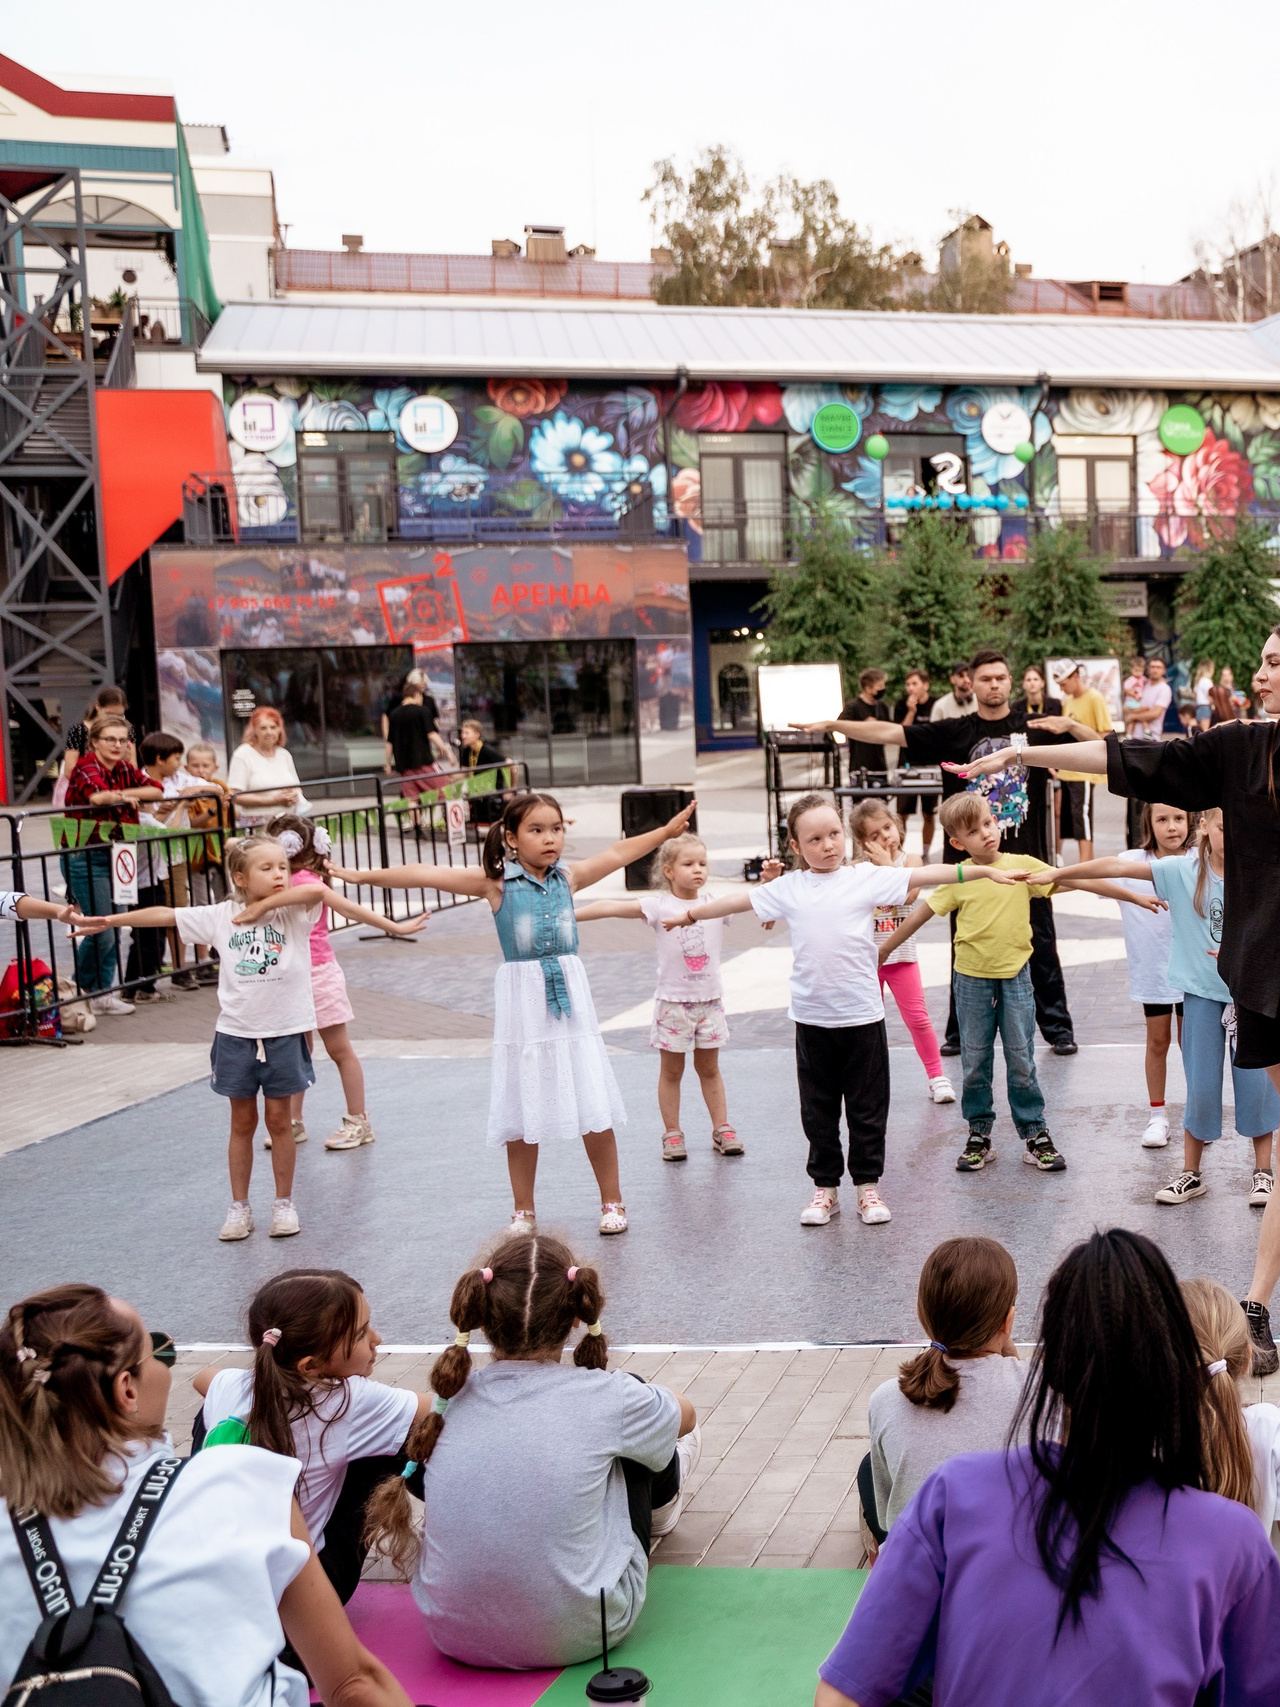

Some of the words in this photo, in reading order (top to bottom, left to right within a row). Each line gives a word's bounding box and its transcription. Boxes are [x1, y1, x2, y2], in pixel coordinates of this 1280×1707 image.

[491, 581, 611, 611] АРЕНДА
[126, 1506, 149, 1542] SPORT
[26, 1527, 47, 1562] SPORT
